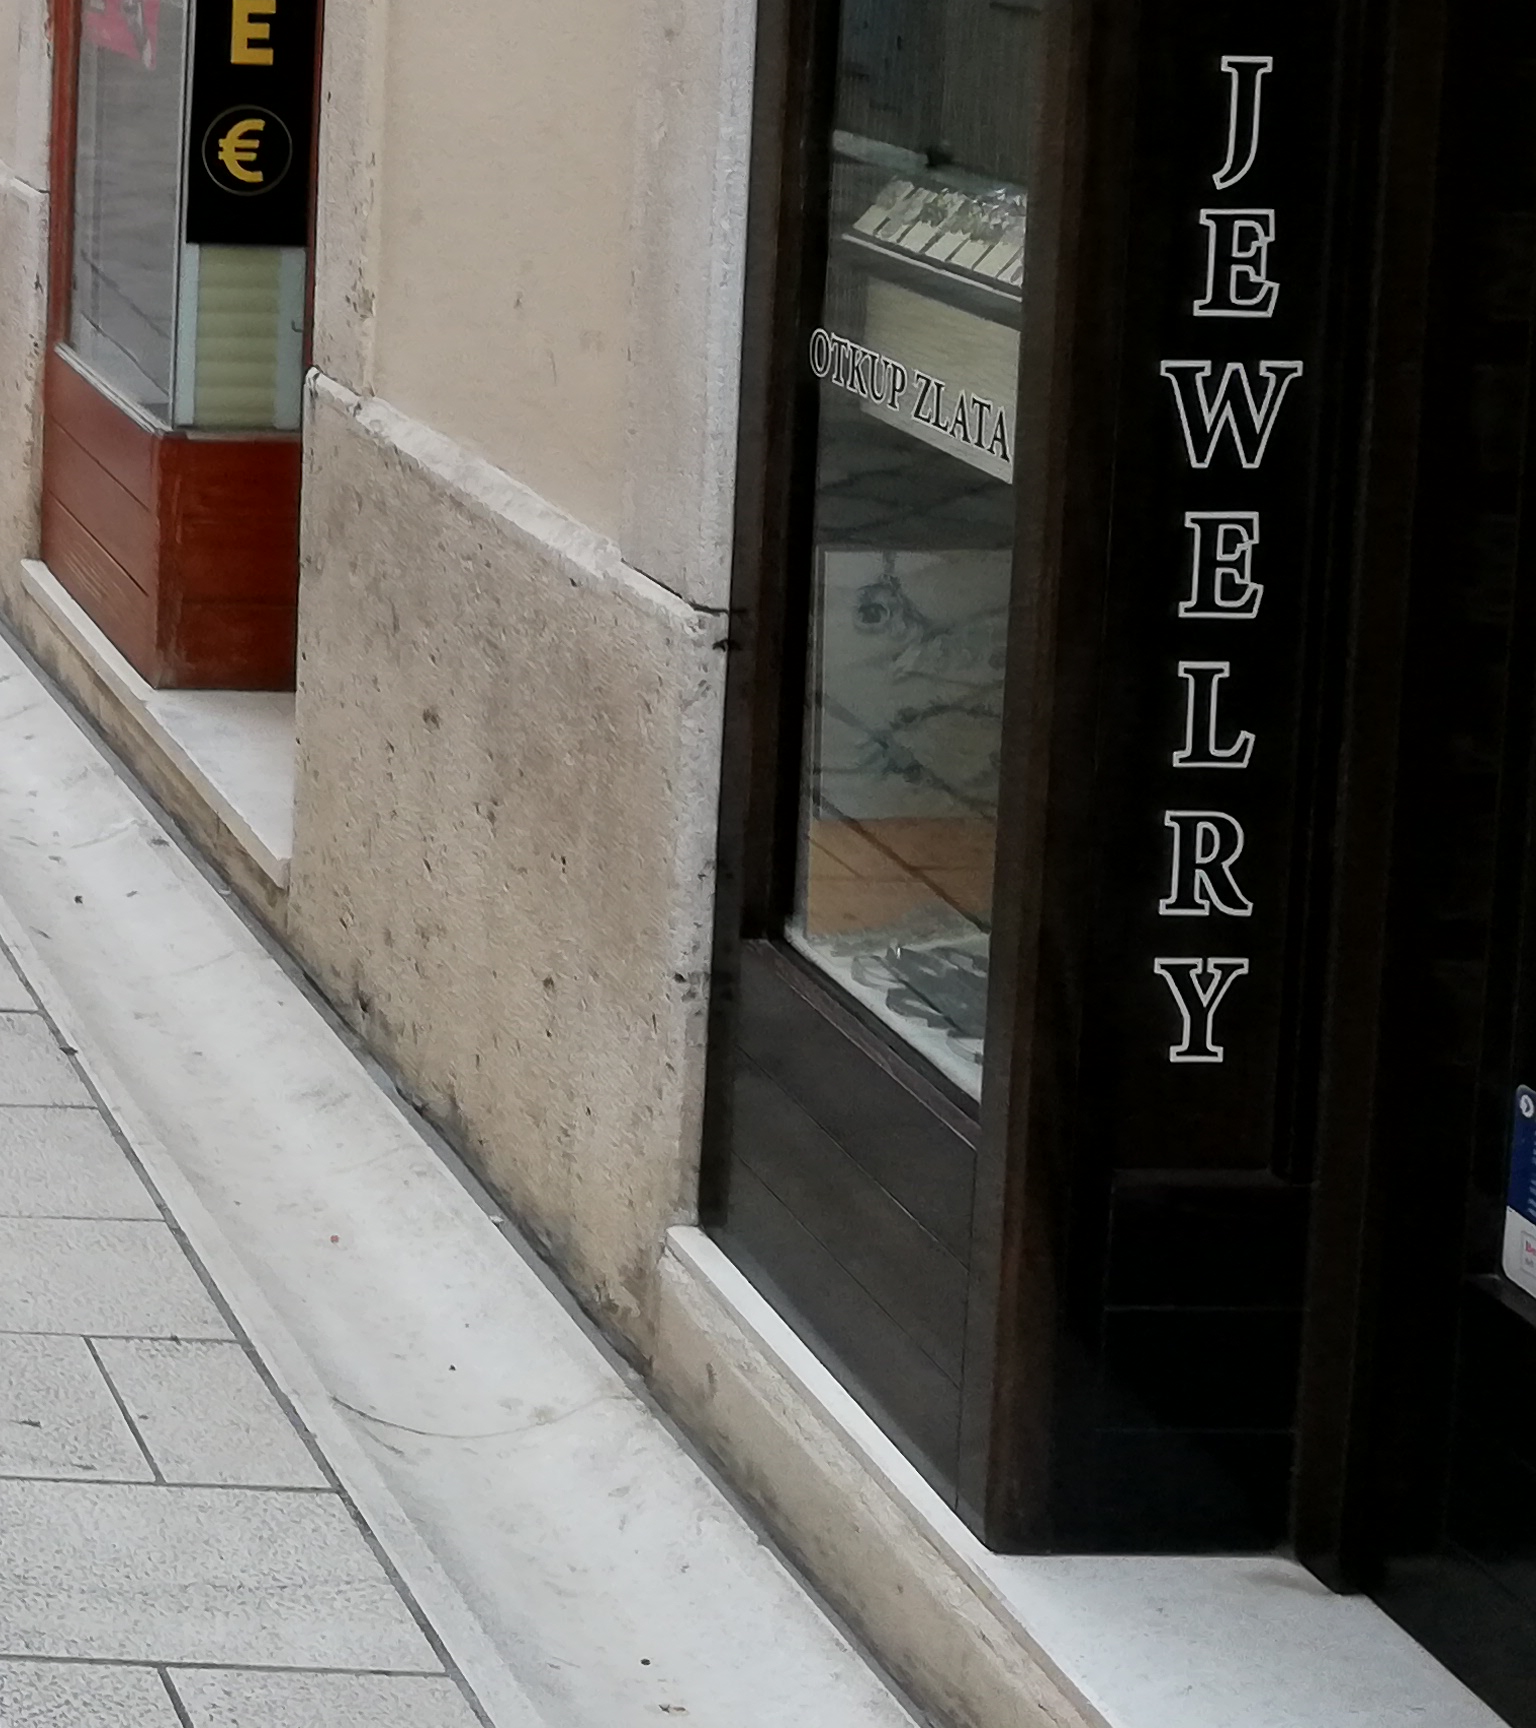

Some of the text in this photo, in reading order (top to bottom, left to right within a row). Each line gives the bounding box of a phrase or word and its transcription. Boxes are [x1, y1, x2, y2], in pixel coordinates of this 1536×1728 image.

[809, 328, 1013, 464] OTKUP ZLATA
[1154, 56, 1303, 1063] JEWELRY
